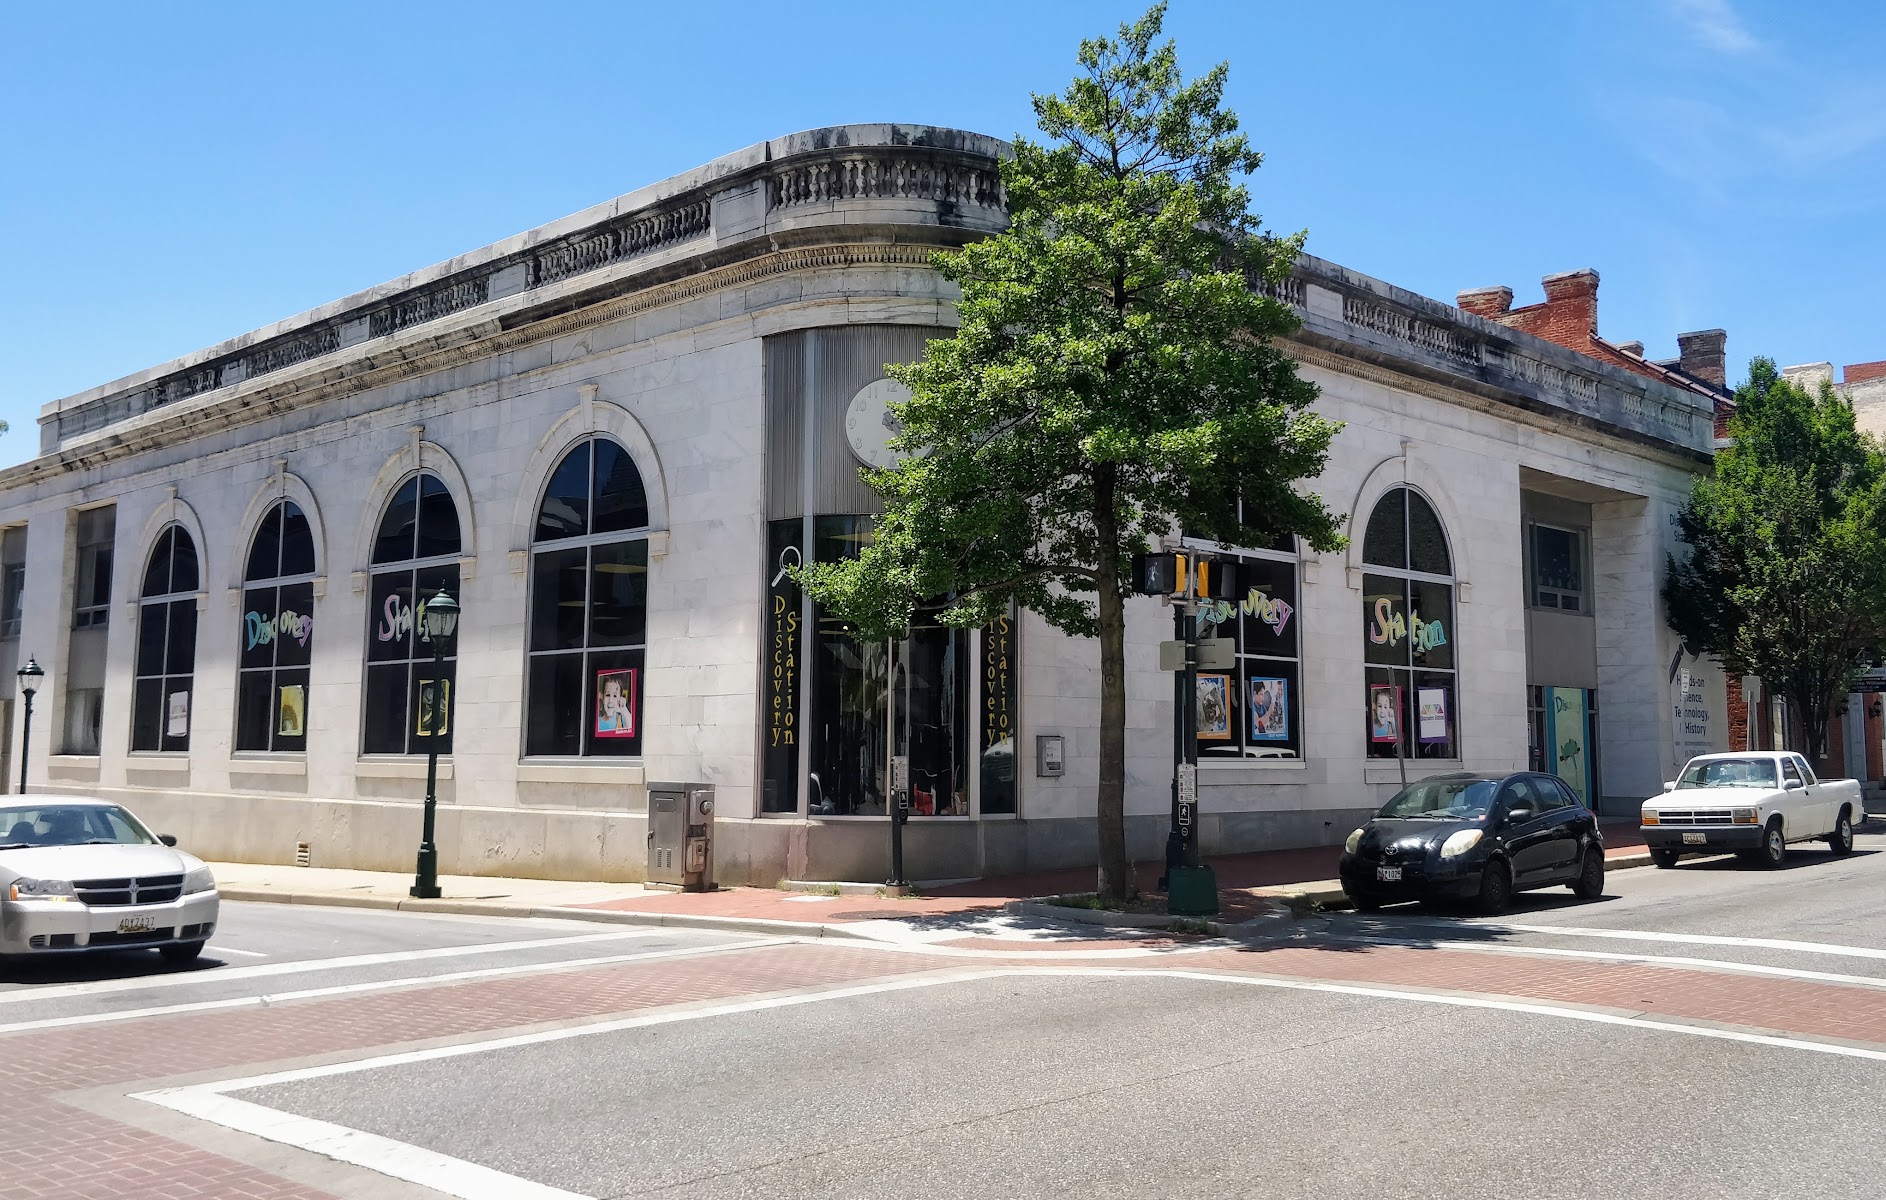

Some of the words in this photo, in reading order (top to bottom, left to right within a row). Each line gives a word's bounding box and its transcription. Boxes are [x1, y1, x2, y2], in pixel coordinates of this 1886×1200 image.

[868, 386, 878, 399] 11
[886, 380, 898, 393] 12
[855, 400, 867, 412] 10
[848, 418, 857, 430] 9
[855, 437, 863, 450] 8
[870, 449, 878, 462] 7
[889, 456, 897, 468] 6
[379, 594, 431, 642] Stati
[245, 610, 313, 651] Discovery
[1370, 598, 1447, 653] Station
[772, 595, 786, 747] Discovery
[783, 611, 797, 744] Station
[986, 618, 997, 748] iscovery
[999, 613, 1010, 745] Station
[1685, 722, 1706, 737] History
